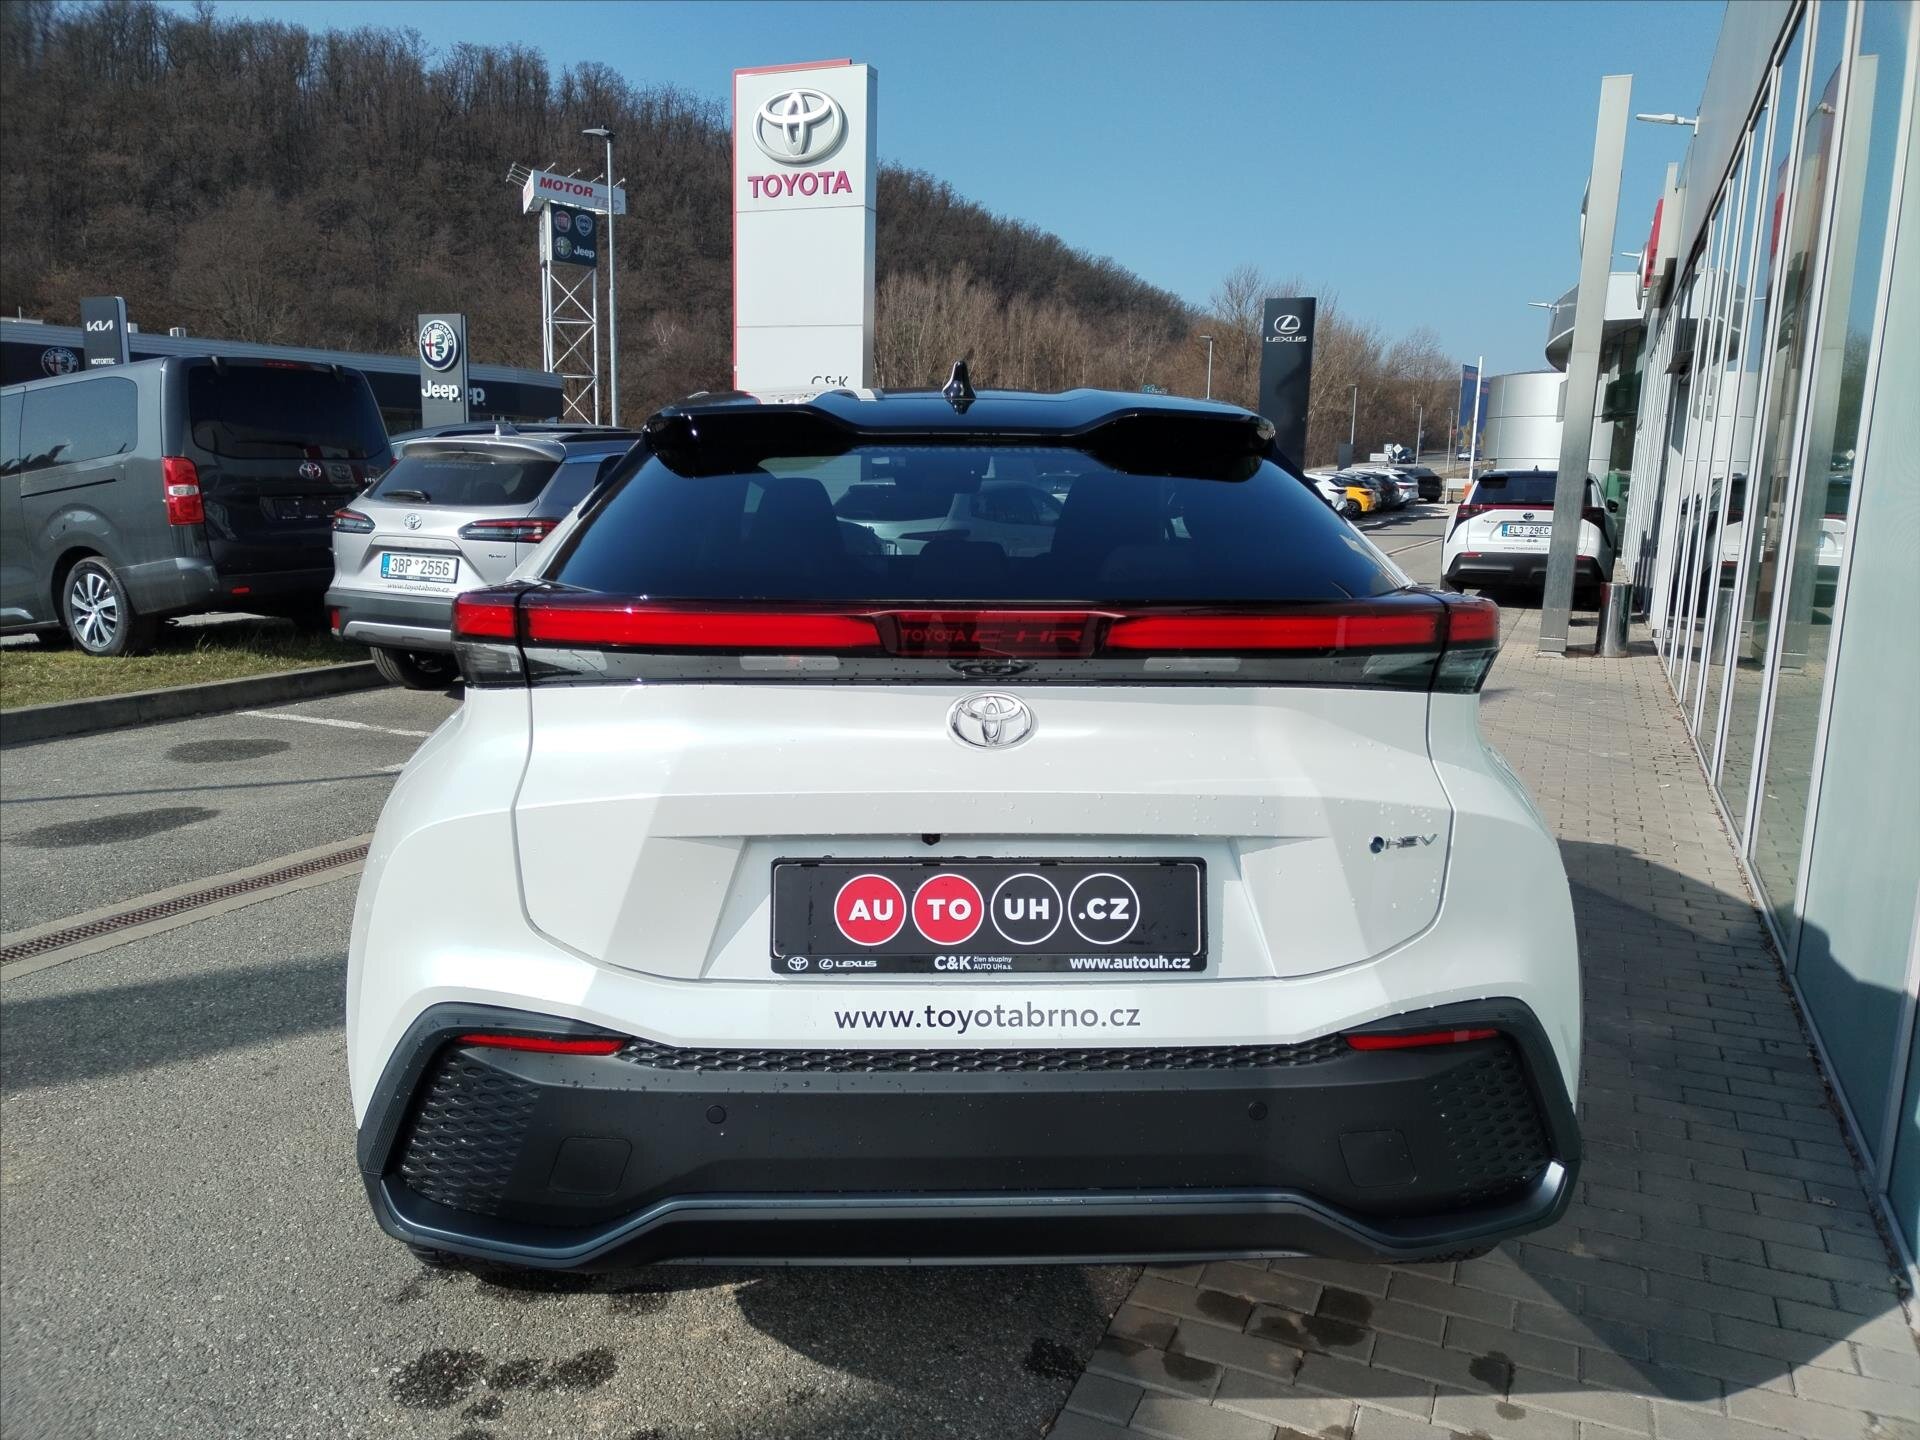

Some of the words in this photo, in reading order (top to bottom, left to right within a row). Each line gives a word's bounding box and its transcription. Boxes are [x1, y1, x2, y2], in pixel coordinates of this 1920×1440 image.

[539, 176, 594, 198] MOTOR
[747, 170, 853, 198] TOYOTA
[573, 245, 595, 258] Jeep
[86, 320, 113, 332] KIA
[434, 323, 453, 346] ROMEO
[1265, 335, 1307, 343] LEXUS
[90, 357, 116, 365] MOTORTEC
[1508, 526, 1524, 534] EL3
[1529, 526, 1549, 535] 29EC
[391, 558, 412, 574] 3BP
[420, 560, 450, 576] 2556
[901, 629, 965, 641] TOYOTA
[971, 630, 1082, 642] C-HR
[1385, 834, 1438, 849] HEV
[848, 899, 894, 921] AU
[926, 898, 972, 921] TO
[1004, 898, 1049, 921] UH
[1078, 898, 1129, 921] .CZ
[835, 960, 877, 968] LEXUS
[934, 955, 972, 970] C&K
[1069, 955, 1191, 969] www.autouh.cz
[834, 1001, 1141, 1035] www.toyotabrno.cz
